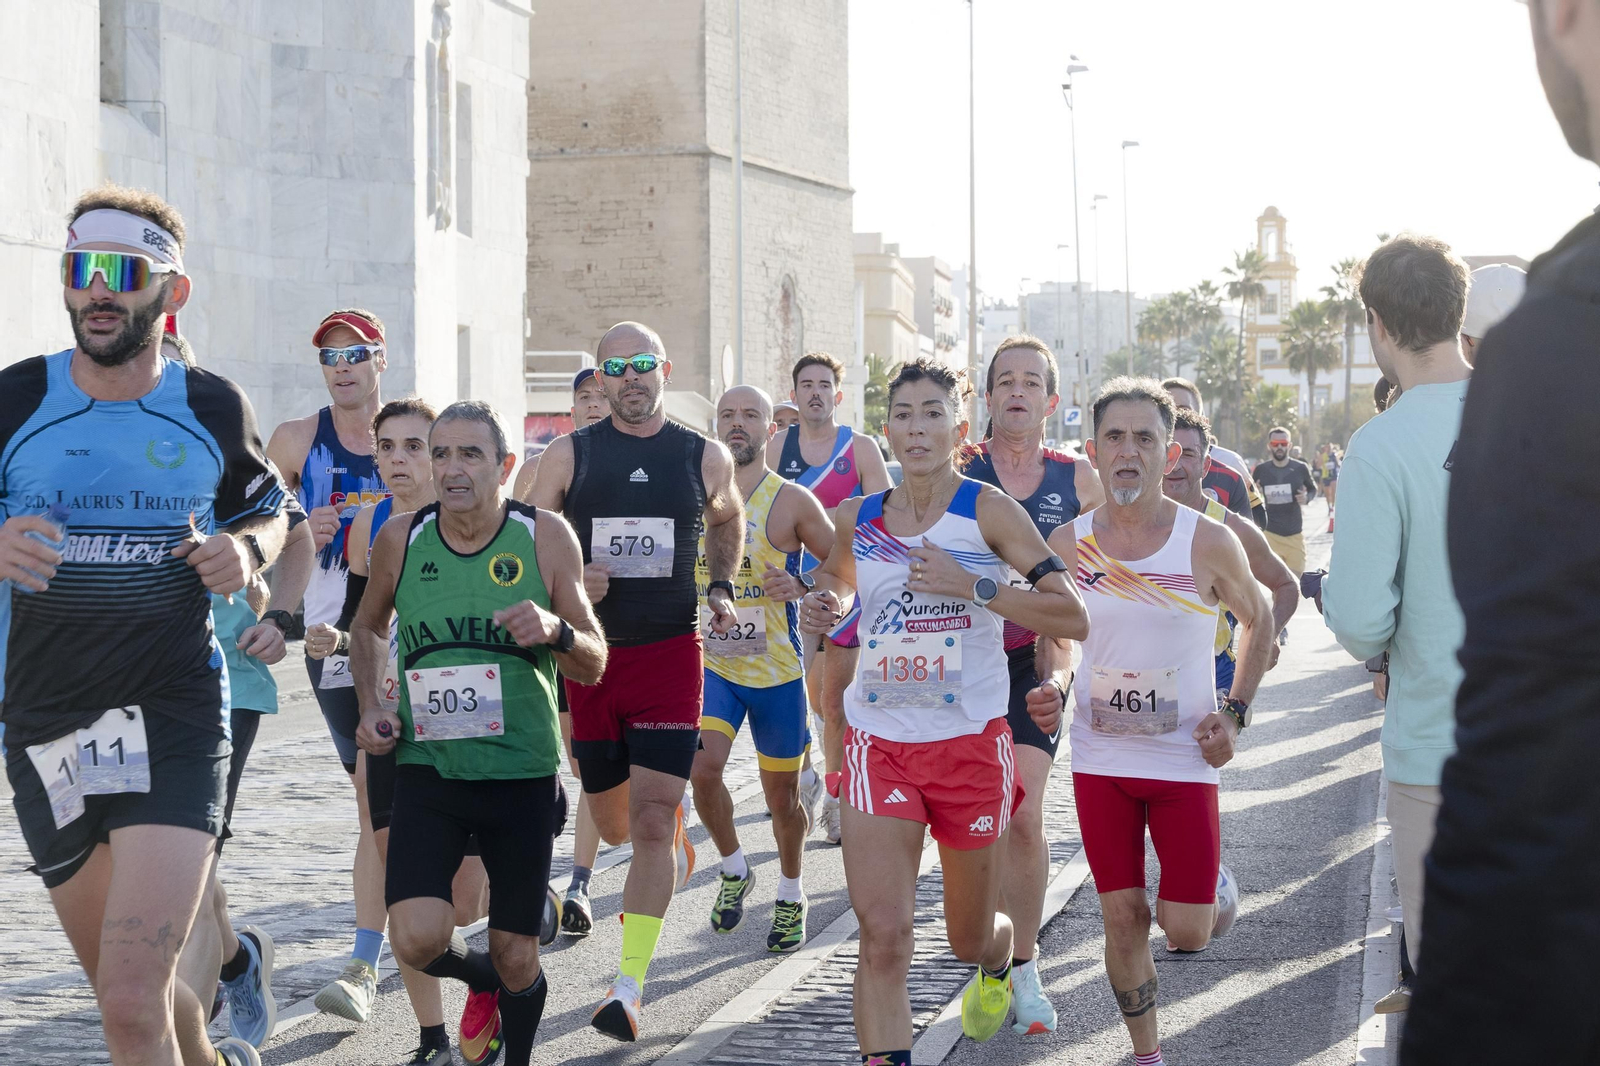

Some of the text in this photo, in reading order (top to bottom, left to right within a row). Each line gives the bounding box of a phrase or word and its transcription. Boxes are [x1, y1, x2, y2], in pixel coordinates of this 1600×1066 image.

[55, 490, 124, 509] LAURUS
[609, 535, 655, 557] 579
[734, 582, 766, 599] CÁDI
[401, 616, 522, 652] VIA VER
[877, 655, 946, 682] 1381
[428, 687, 478, 715] 503
[1109, 689, 1156, 713] 461
